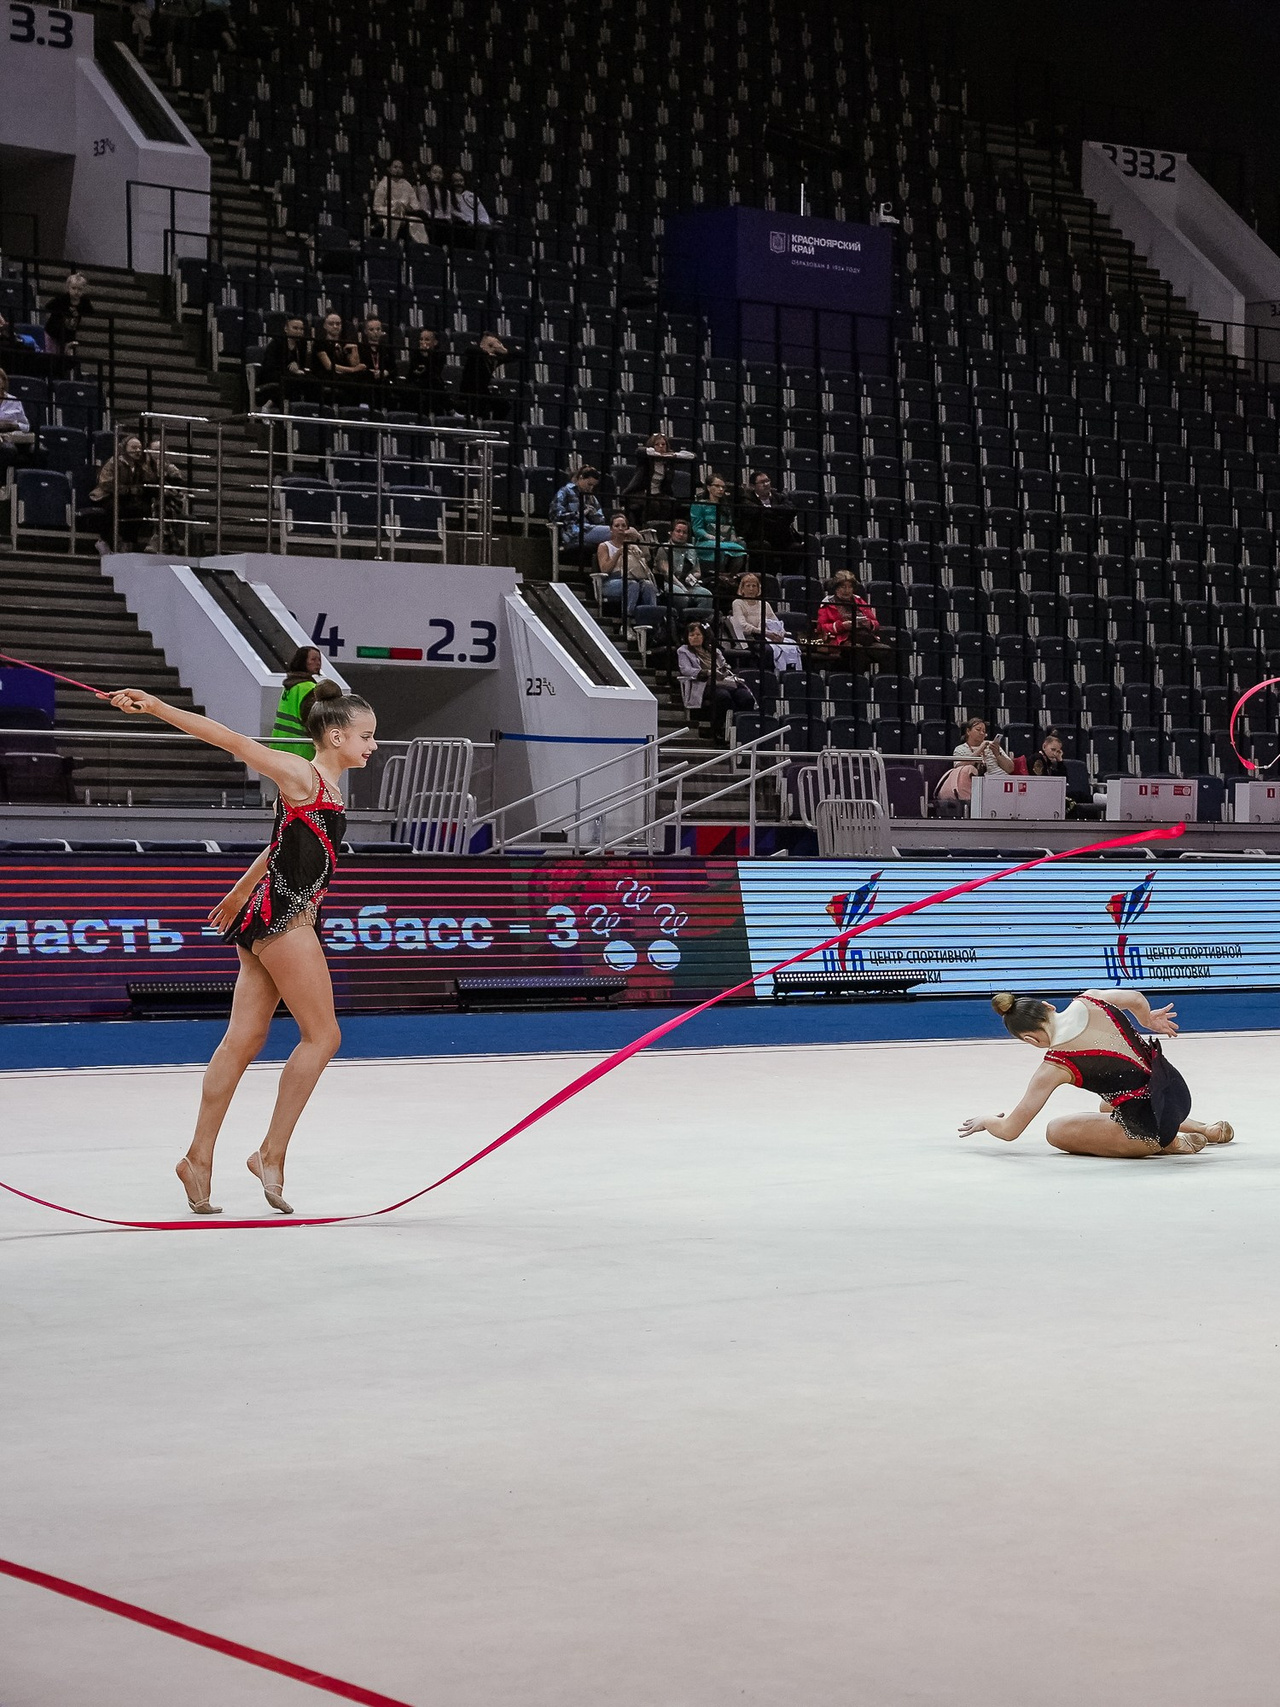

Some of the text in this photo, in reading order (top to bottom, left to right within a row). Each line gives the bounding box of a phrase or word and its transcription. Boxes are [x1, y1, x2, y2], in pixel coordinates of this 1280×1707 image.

[9, 4, 74, 49] 3.3
[791, 234, 861, 251] КРАСНОЯРСКИЙ
[791, 244, 815, 255] КРАЙ
[426, 618, 497, 663] 2.3
[869, 947, 977, 966] ЦЕНТР СПОРТИВНОЙ
[1145, 943, 1243, 962] ЦЕНТР СПОРТИВНОЙ
[1149, 966, 1211, 982] ПОДГОТОВКИ
